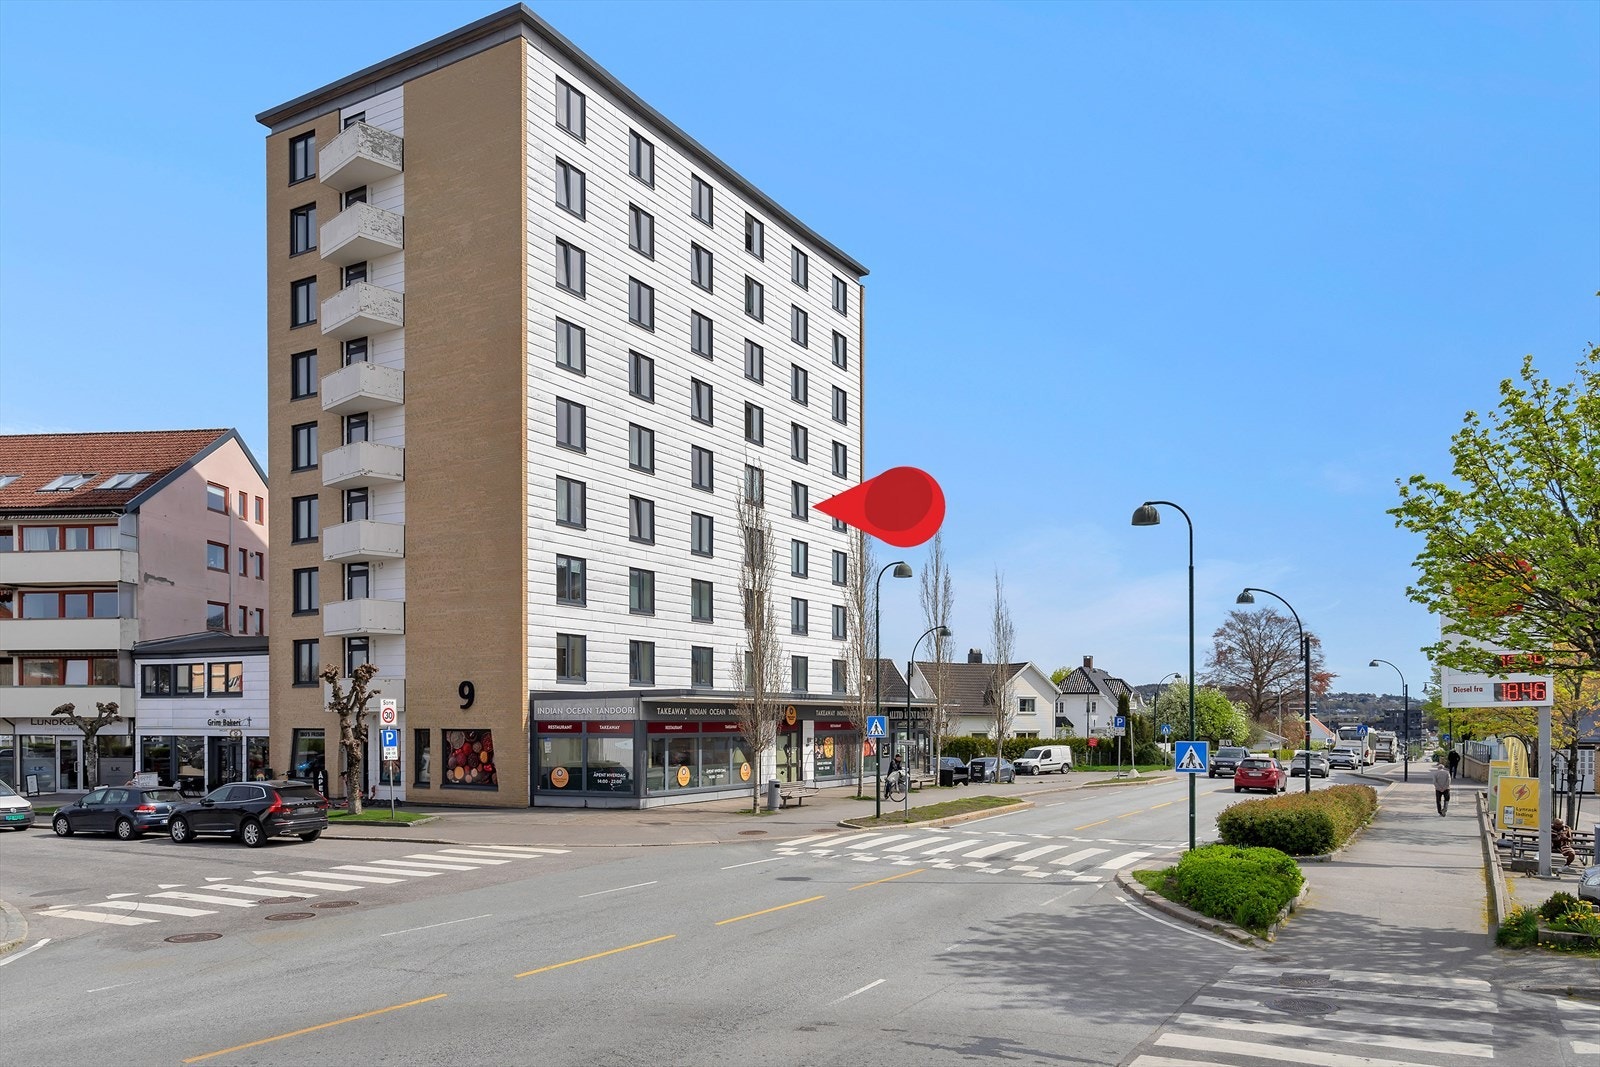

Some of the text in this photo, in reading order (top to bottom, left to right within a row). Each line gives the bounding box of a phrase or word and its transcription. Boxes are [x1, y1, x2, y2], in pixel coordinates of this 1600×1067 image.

[458, 680, 475, 710] 9
[1500, 682, 1546, 702] 18.46
[656, 707, 687, 715] TAKEAWAY
[384, 712, 392, 720] 30
[208, 718, 241, 726] Grim Bakeri
[1117, 718, 1124, 726] P
[386, 732, 394, 745] P
